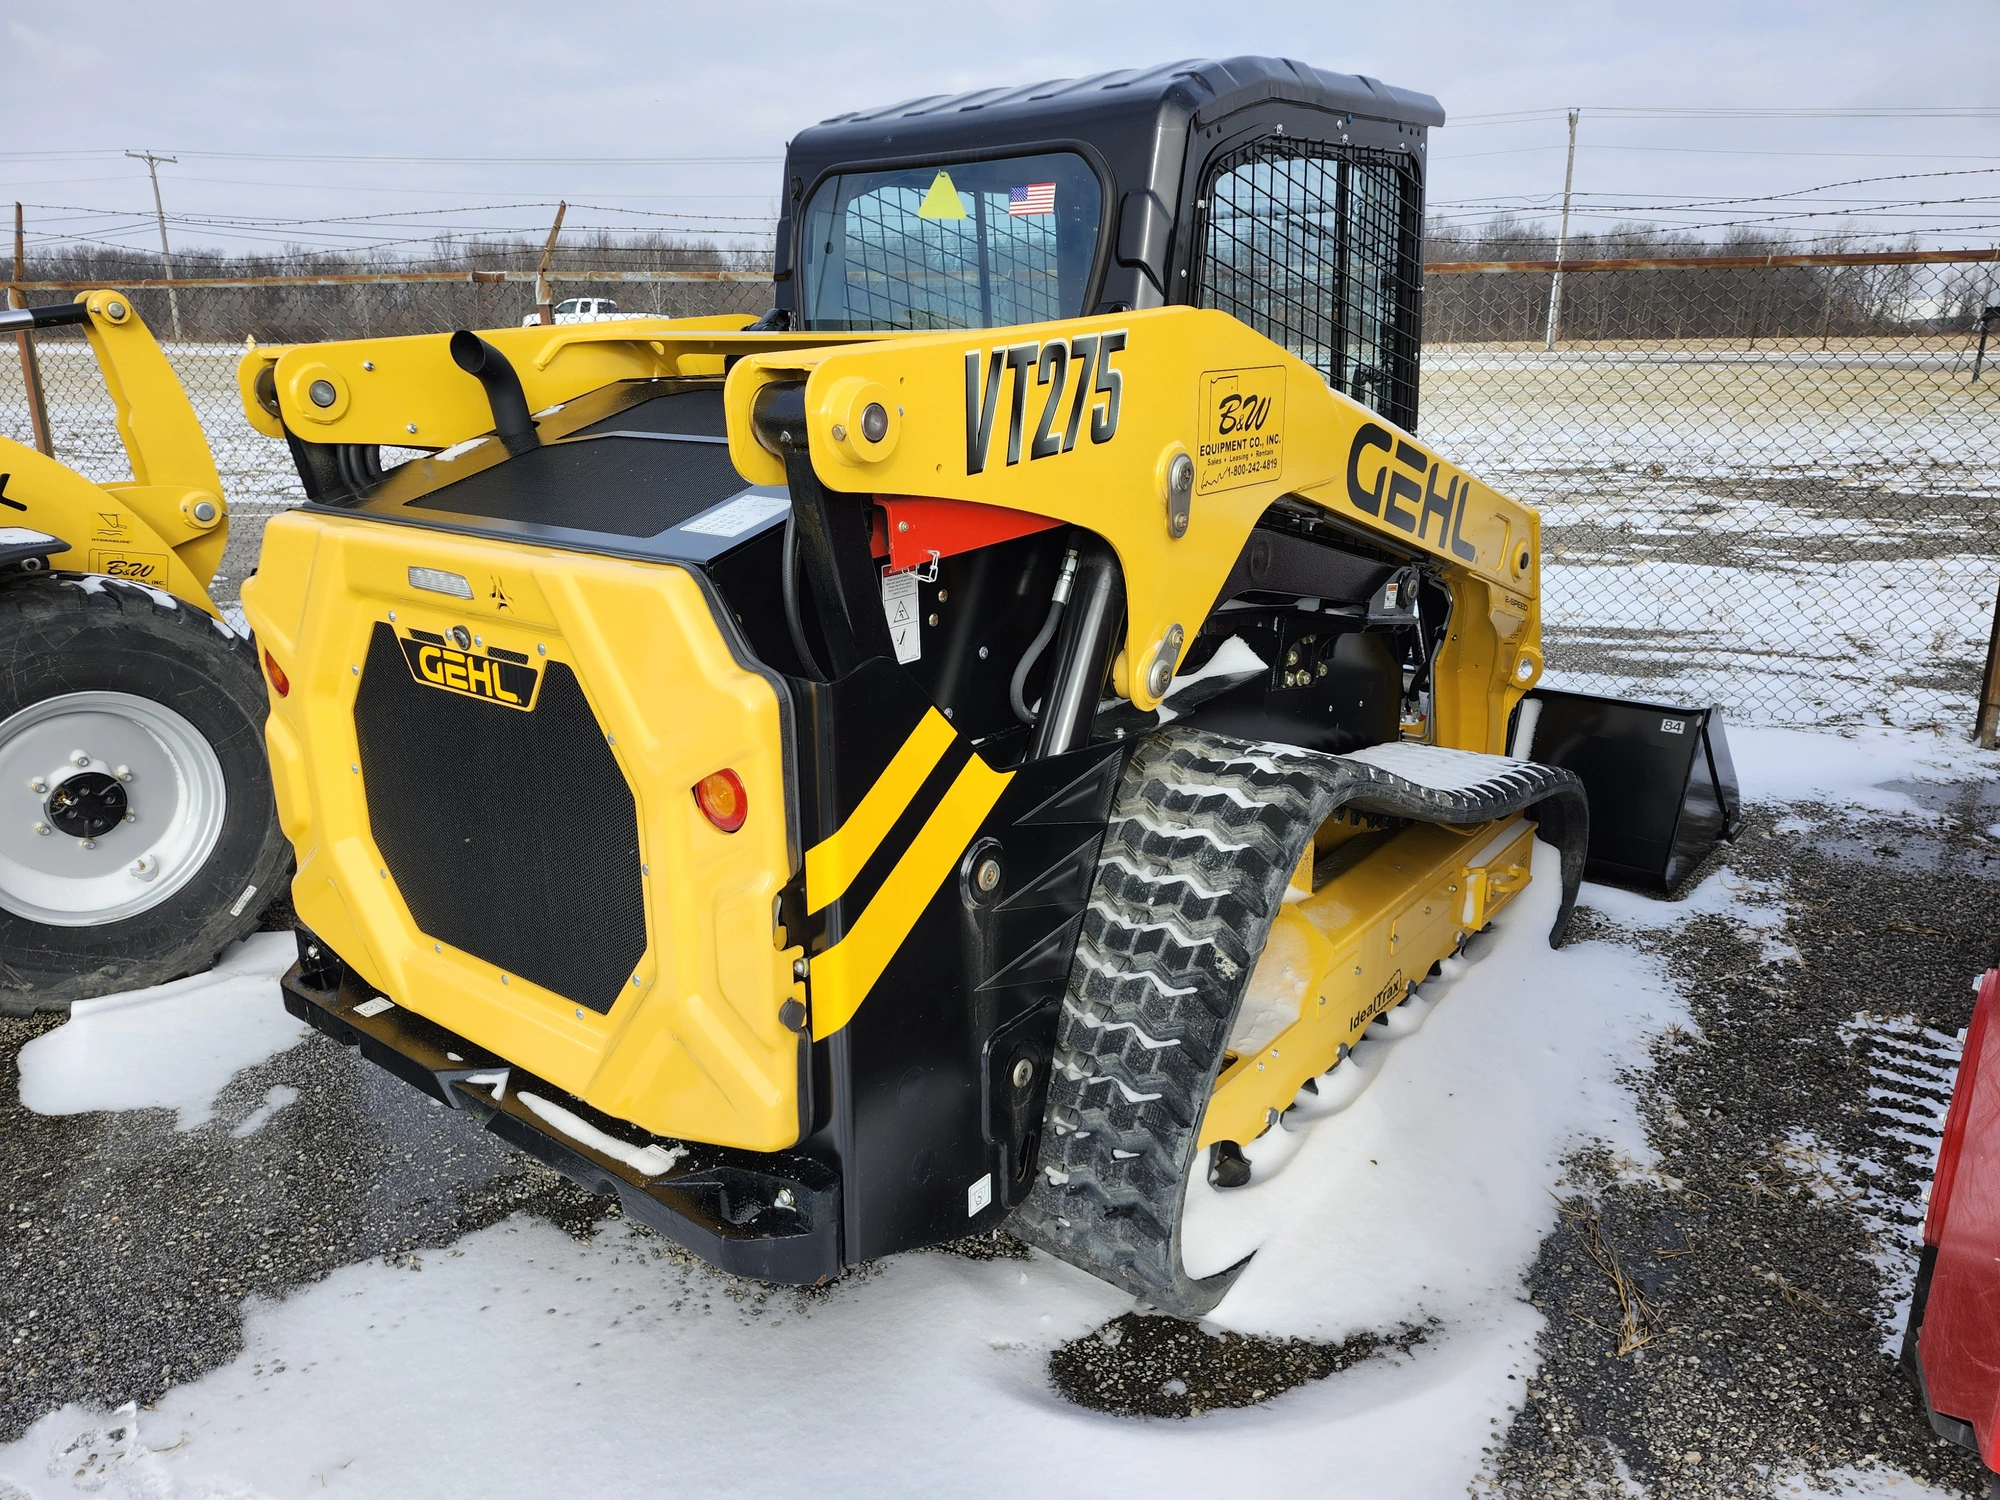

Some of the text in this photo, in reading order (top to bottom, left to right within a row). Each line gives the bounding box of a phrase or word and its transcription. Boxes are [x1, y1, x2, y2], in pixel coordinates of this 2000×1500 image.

[965, 328, 1129, 476] VT275
[1218, 393, 1272, 435] B&W
[1199, 438, 1248, 457] EQUIPMENT
[1266, 433, 1282, 446] INC.
[1206, 448, 1274, 467] Sales Leasing Rentals
[1227, 457, 1278, 478] 1-800-242-4819
[1346, 422, 1476, 563] GEHL
[106, 560, 155, 577] B&W
[418, 645, 520, 704] GEHL
[1663, 720, 1682, 732] 84
[1349, 980, 1400, 1033] IdealTrax
